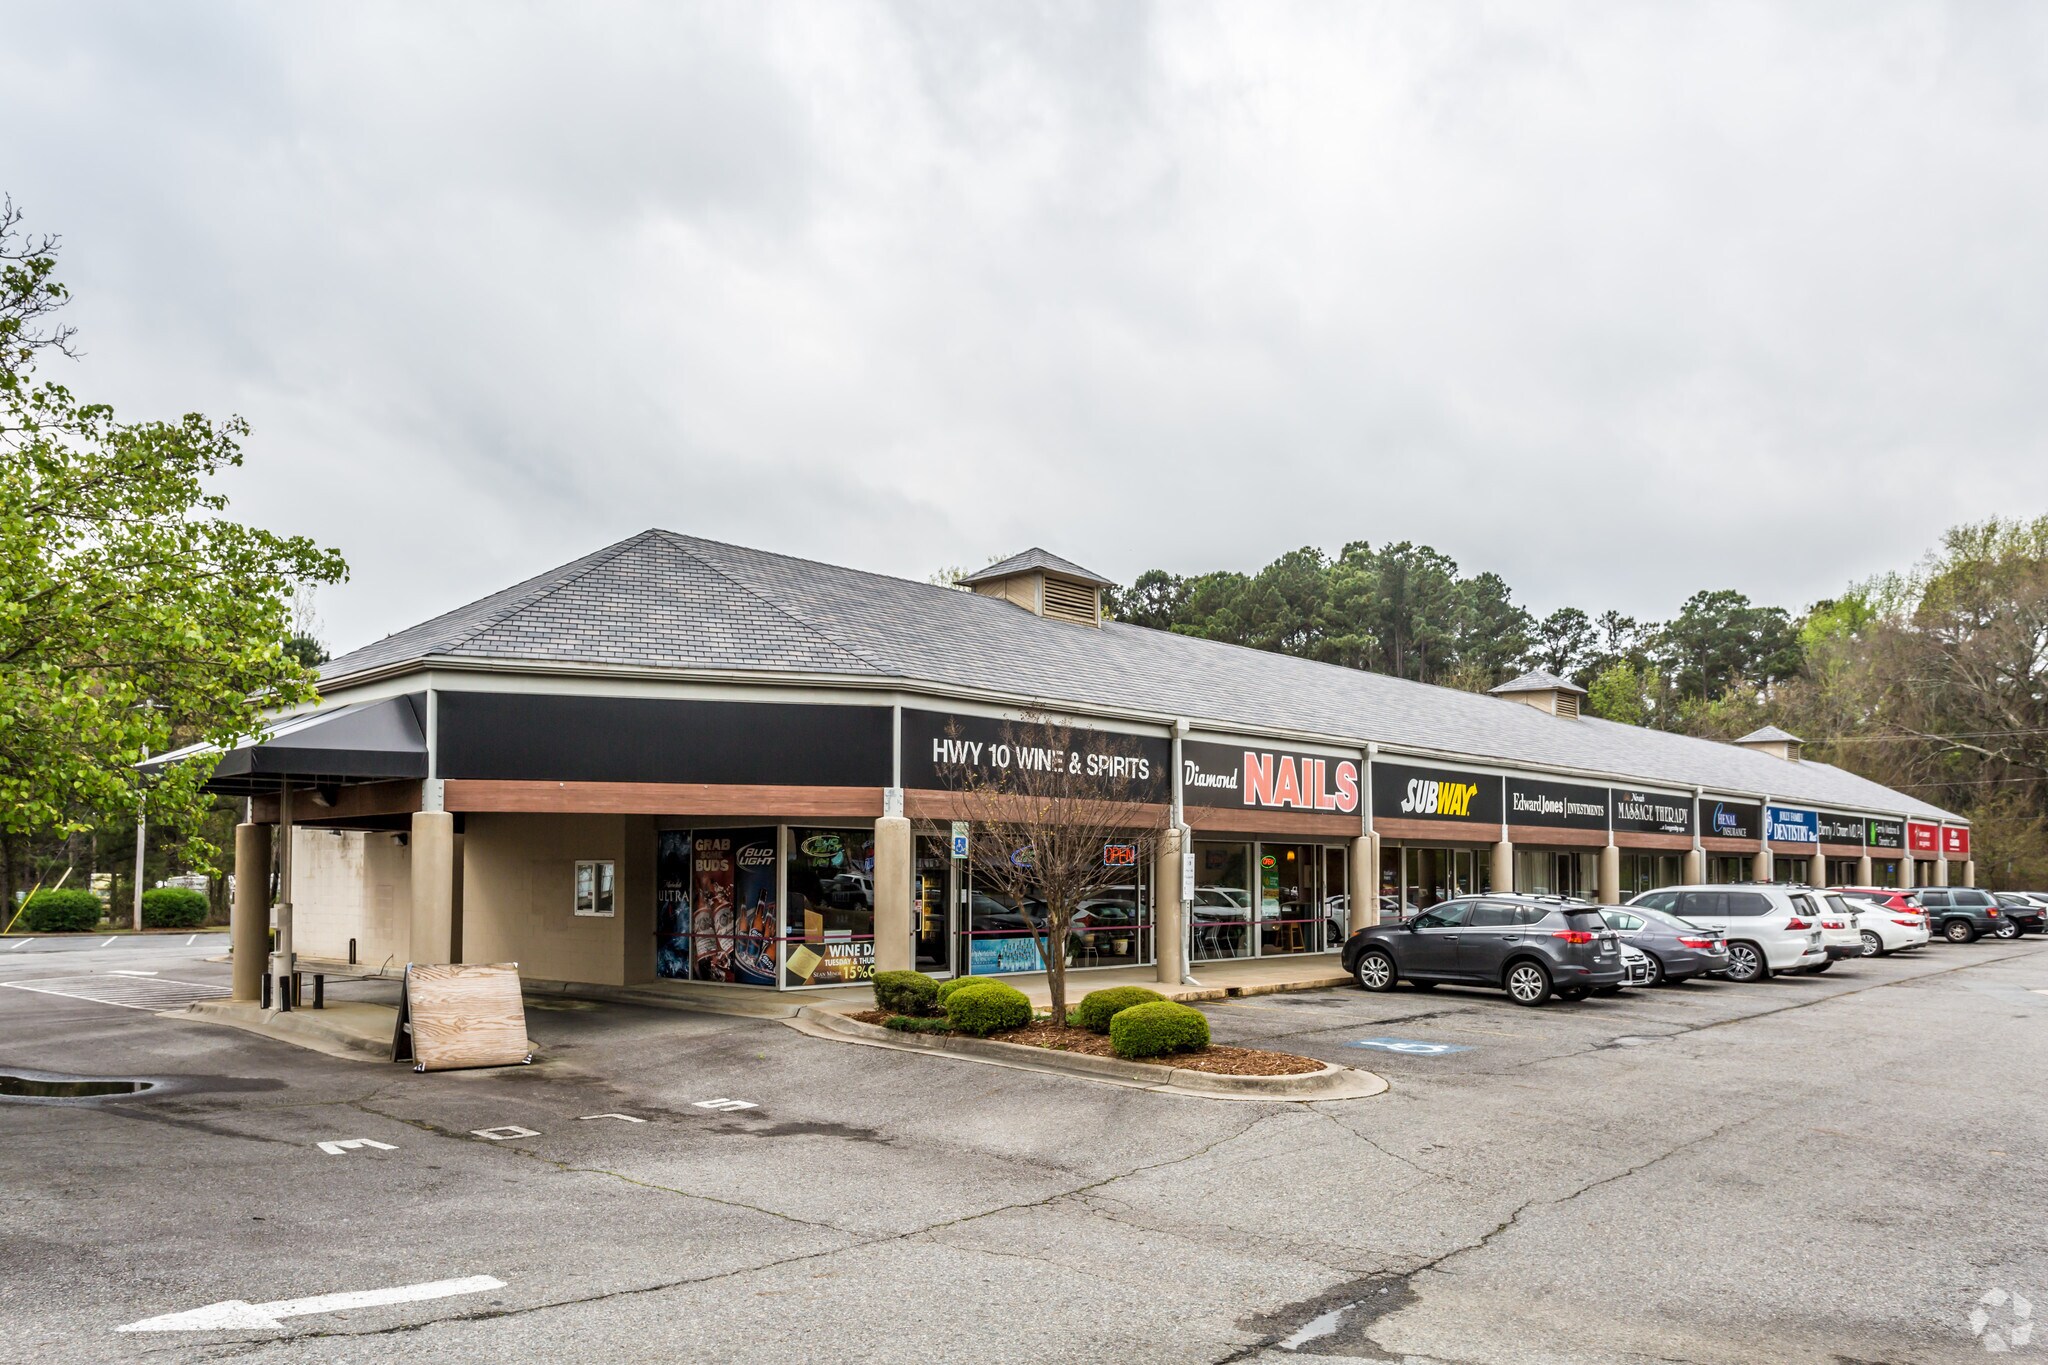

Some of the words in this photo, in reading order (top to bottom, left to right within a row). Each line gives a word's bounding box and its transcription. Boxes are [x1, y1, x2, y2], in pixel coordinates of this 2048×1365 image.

[933, 738, 983, 766] HWY
[988, 743, 1011, 768] 10
[1015, 746, 1064, 773] WINE
[1069, 751, 1082, 775] &
[1086, 753, 1150, 780] SPIRITS
[1184, 760, 1238, 790] Diamond
[1243, 751, 1359, 813] NAILS
[1400, 778, 1478, 817] SUBWAY
[1567, 802, 1604, 817] INVESTMENTS
[1618, 802, 1654, 822] MASSAGE
[1655, 805, 1689, 824] THERAPY
[1723, 828, 1747, 837] INSURANCE
[1774, 823, 1809, 842] DENTISTRY
[695, 838, 731, 851] GRAB
[700, 850, 723, 859] SOME
[745, 847, 774, 857] BUD
[1105, 846, 1135, 865] OPEN
[695, 859, 729, 872] BUDS
[740, 857, 775, 865] LIGHT
[658, 890, 690, 902] ULTRA
[829, 944, 860, 957] WINE
[824, 958, 852, 967] TUESDAY
[852, 957, 858, 965] &
